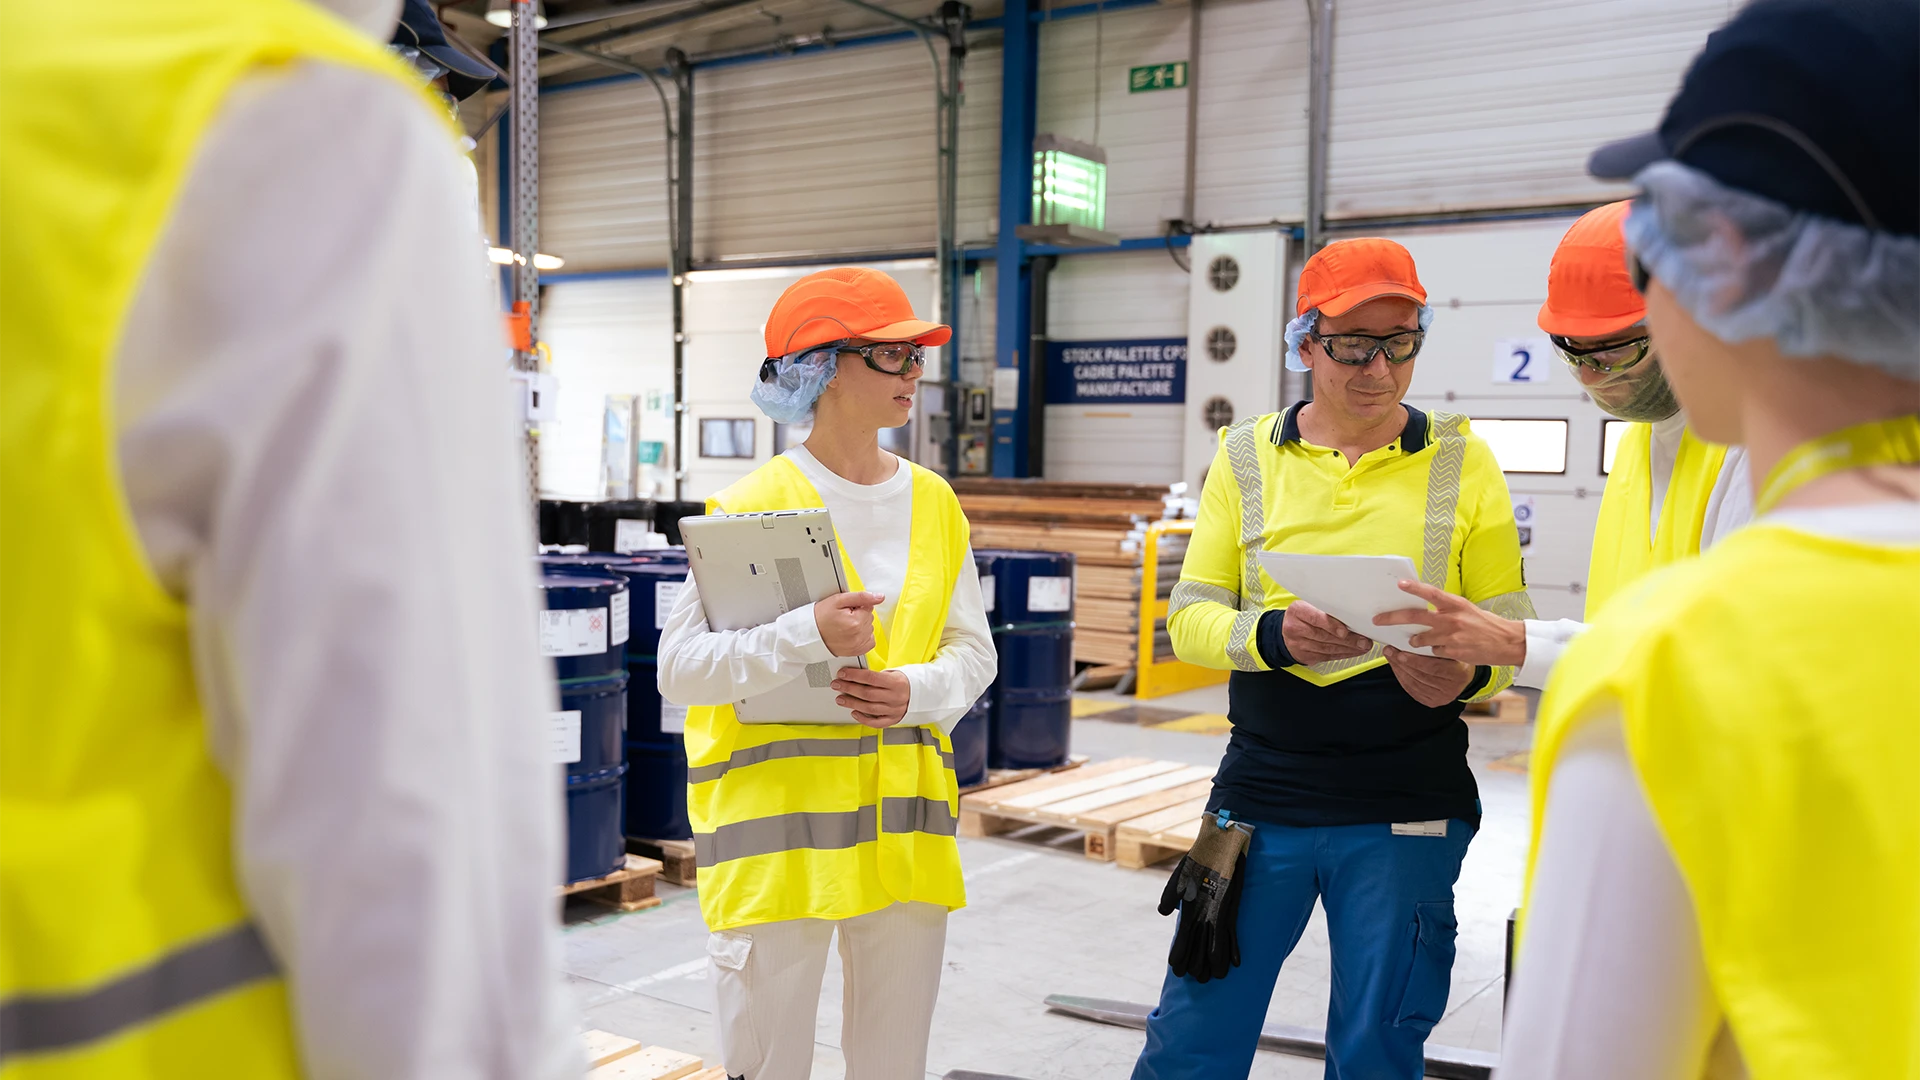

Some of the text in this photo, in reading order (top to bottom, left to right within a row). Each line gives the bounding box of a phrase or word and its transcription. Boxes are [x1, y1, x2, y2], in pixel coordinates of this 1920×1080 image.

[1062, 348, 1104, 363] STOCK
[1106, 347, 1161, 361] PALETTE
[1074, 363, 1175, 379] CADRE PALETTE
[1511, 350, 1531, 381] 2
[1077, 381, 1171, 396] MANUFACTURE
